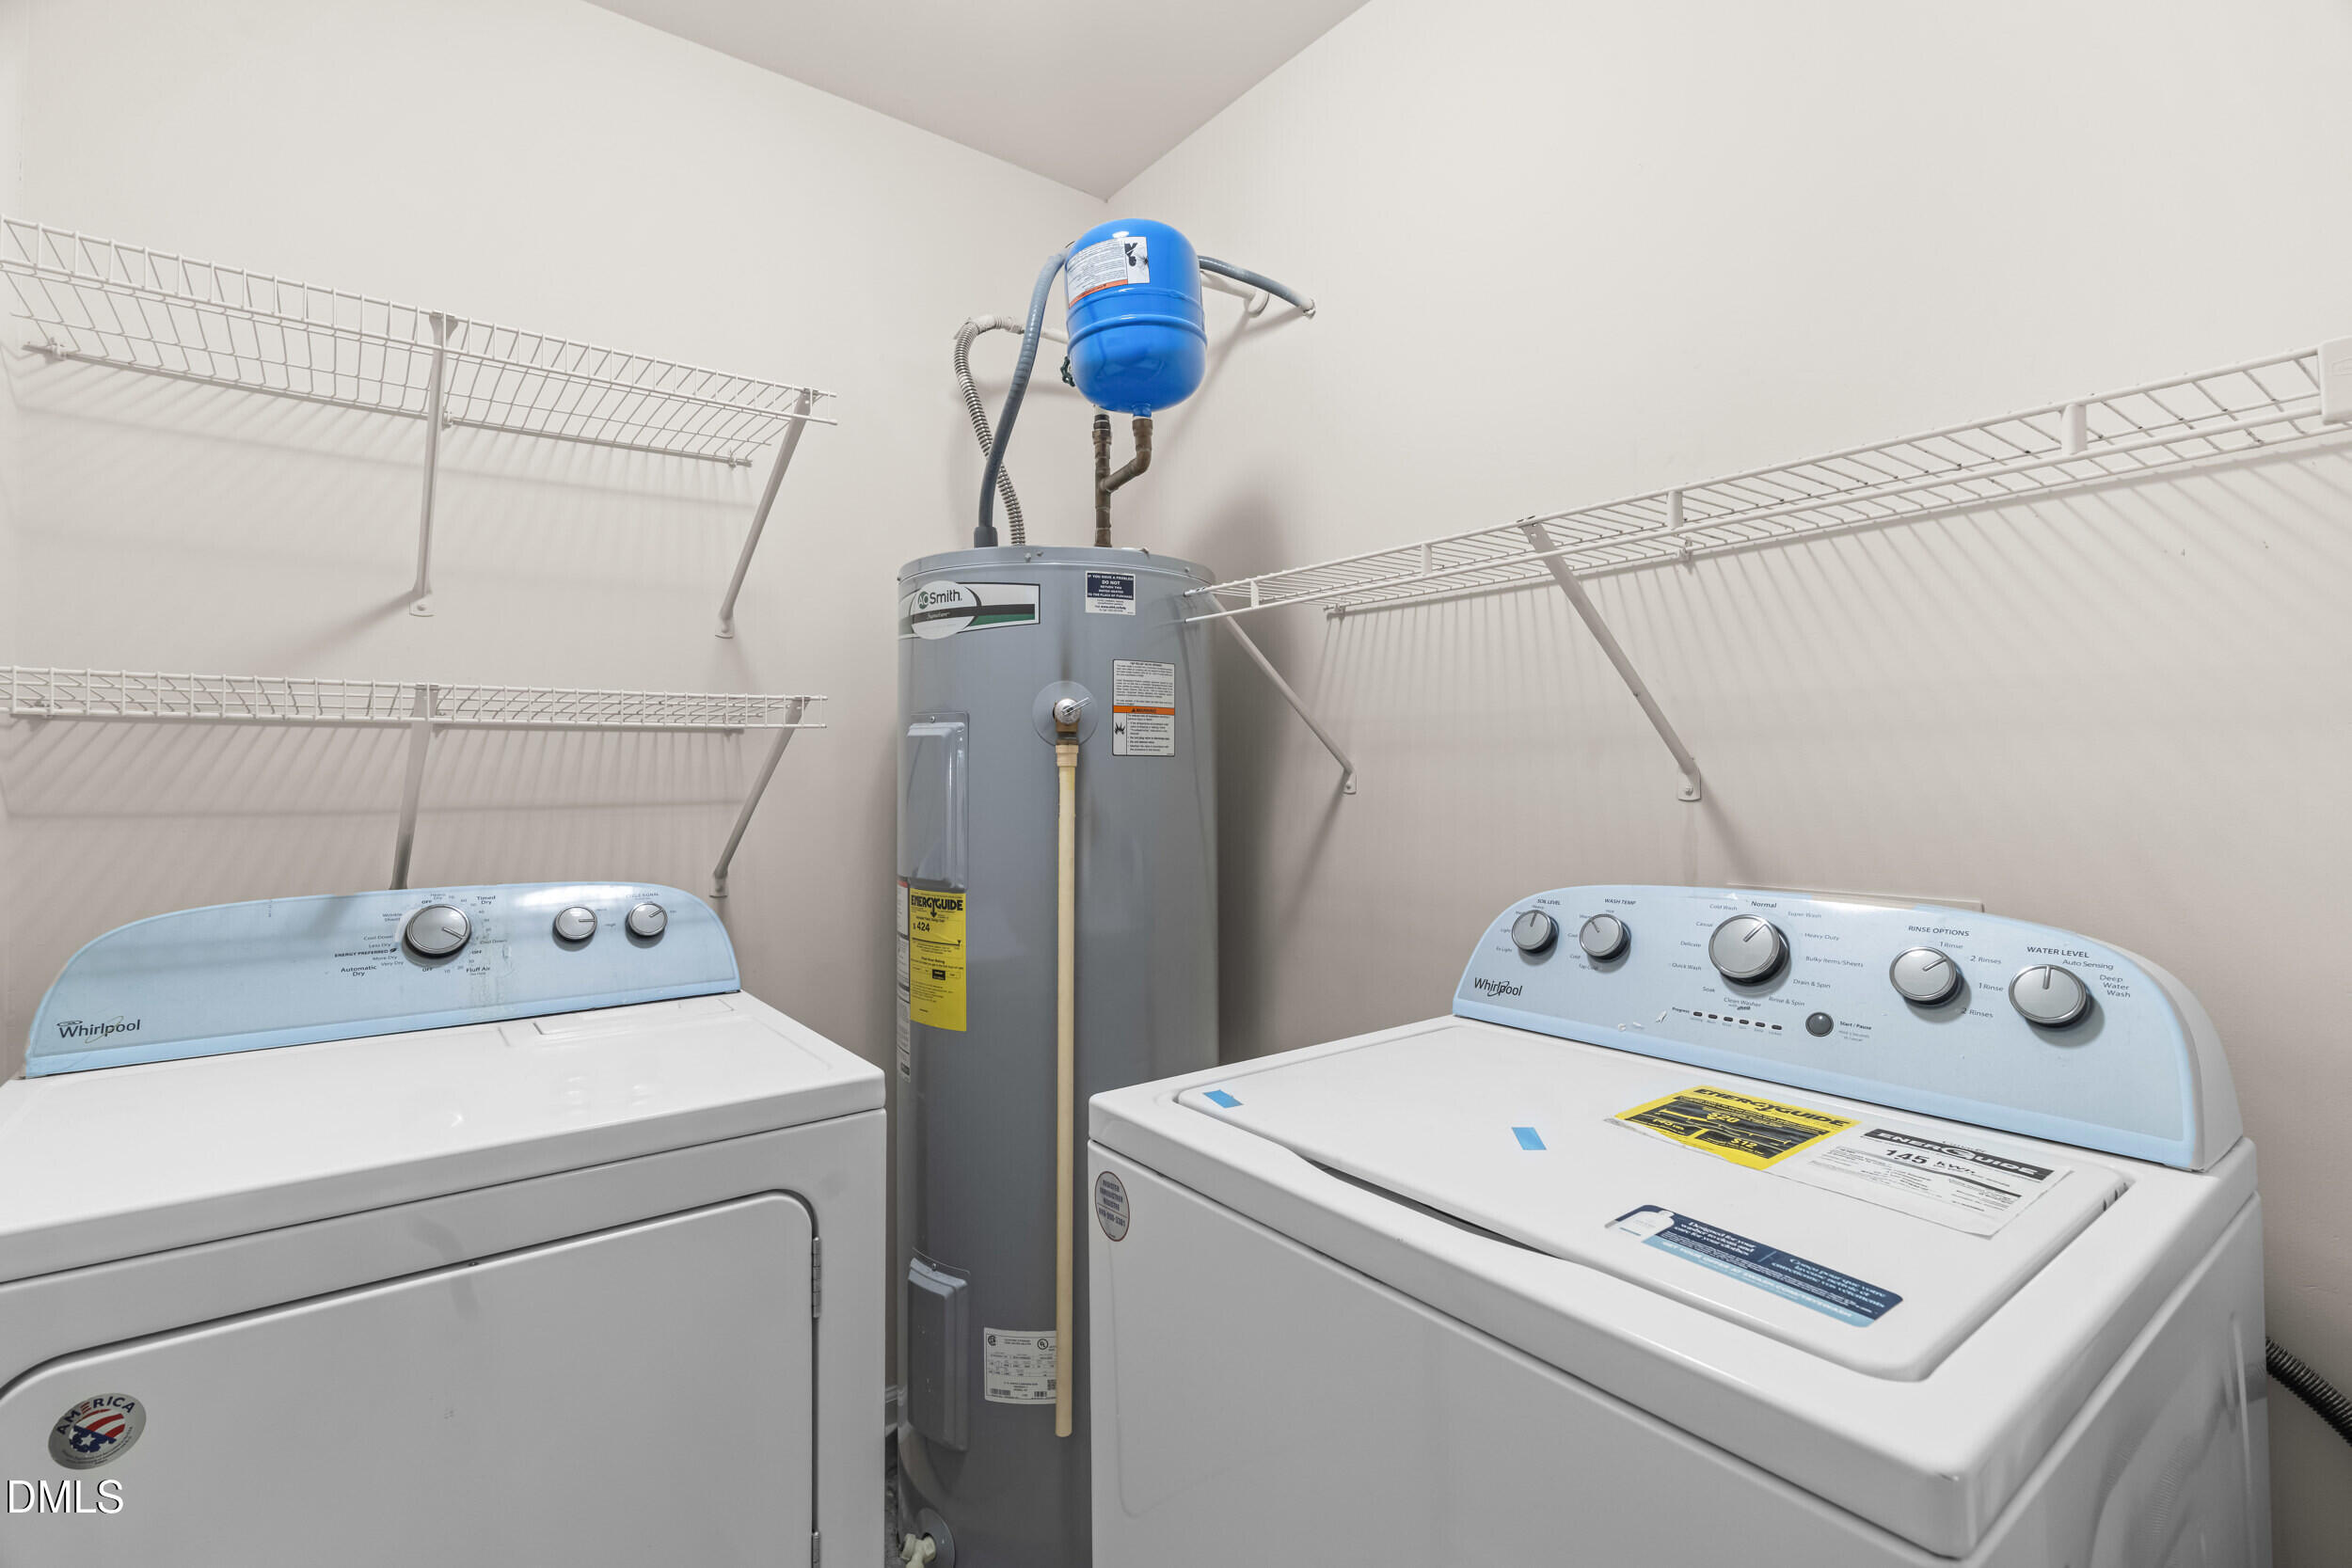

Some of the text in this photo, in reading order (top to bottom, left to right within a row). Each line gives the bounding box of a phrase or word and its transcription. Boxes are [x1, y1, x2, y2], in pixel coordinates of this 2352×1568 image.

[930, 589, 961, 605] Smith
[911, 895, 964, 912] ENERGYGUIDE
[1932, 927, 1970, 937] OPTIONS
[2026, 946, 2090, 958] WATER LEVEL
[1978, 956, 2002, 964] Rinses
[2083, 960, 2114, 971] Sensing
[2099, 974, 2123, 983] Deep
[1474, 977, 1523, 996] Whirlpool
[1983, 983, 2004, 991] Rinse
[2103, 982, 2130, 990] Water
[2106, 990, 2131, 998] Wash
[1740, 999, 1761, 1007] Washer
[1969, 1009, 1994, 1018] Rinses
[58, 1019, 140, 1039] Whirlpool
[1693, 1088, 1851, 1128] ENERGYGUIDE
[1885, 1148, 1931, 1164] 145
[1688, 1222, 1725, 1238] Designed
[1738, 1239, 1757, 1248] your
[1737, 1244, 1756, 1253] and
[56, 1396, 135, 1435] AMERICA
